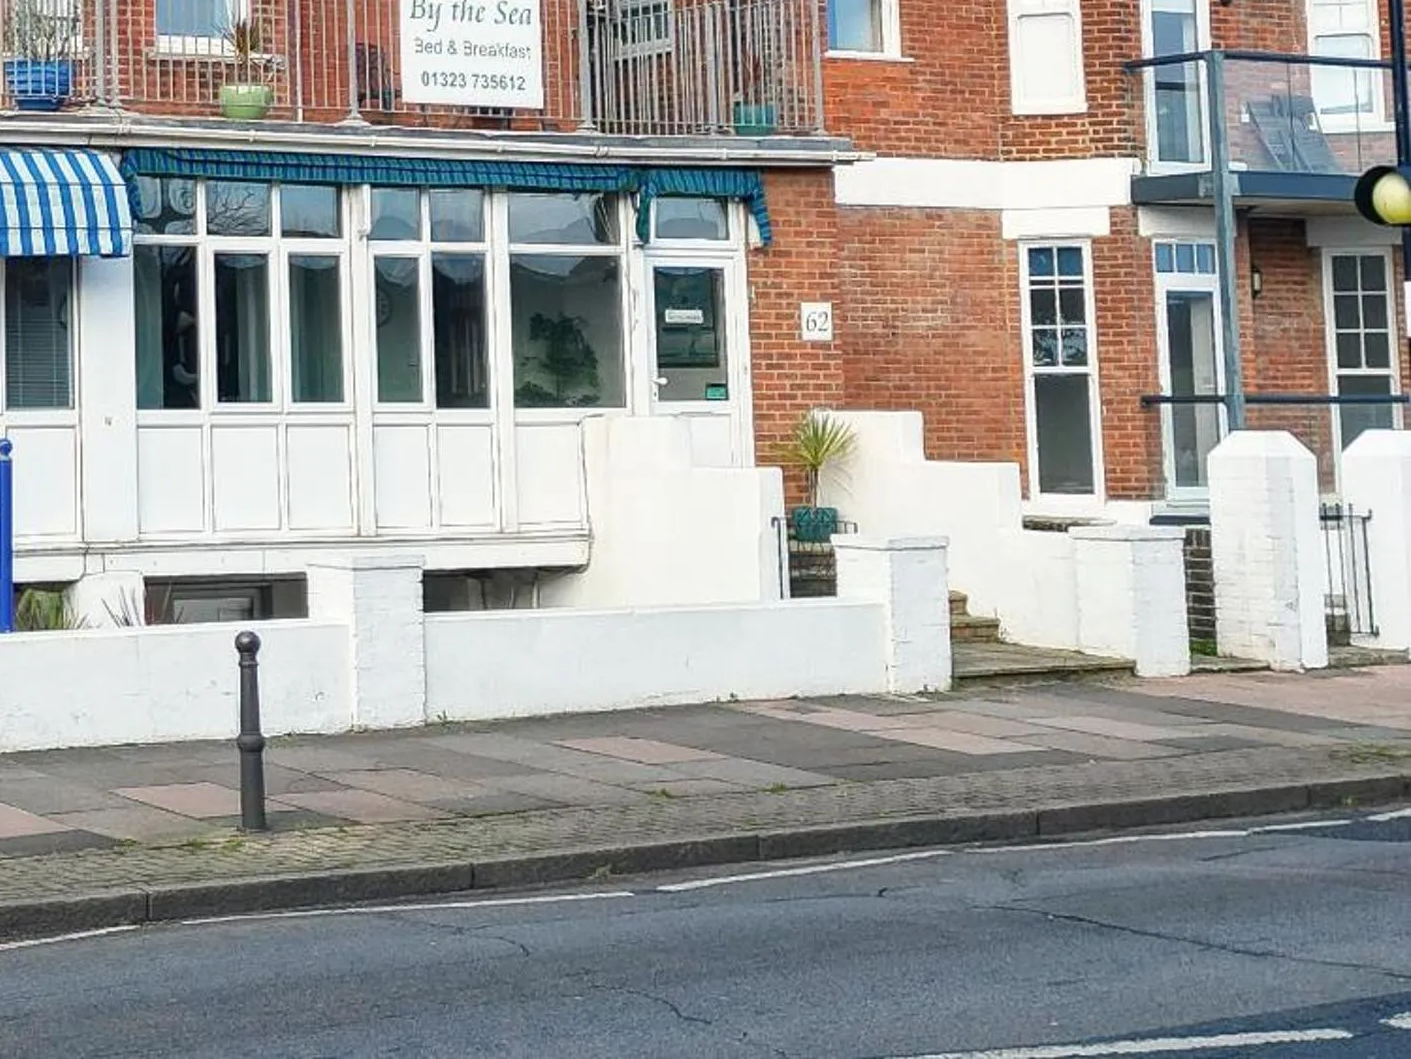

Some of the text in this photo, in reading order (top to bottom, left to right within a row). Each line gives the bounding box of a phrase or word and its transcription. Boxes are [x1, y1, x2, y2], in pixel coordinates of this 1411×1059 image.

[494, 0, 532, 25] Sea
[414, 37, 531, 60] Bed & Breakfast
[421, 70, 526, 91] 01323 735612
[805, 311, 829, 332] 62
